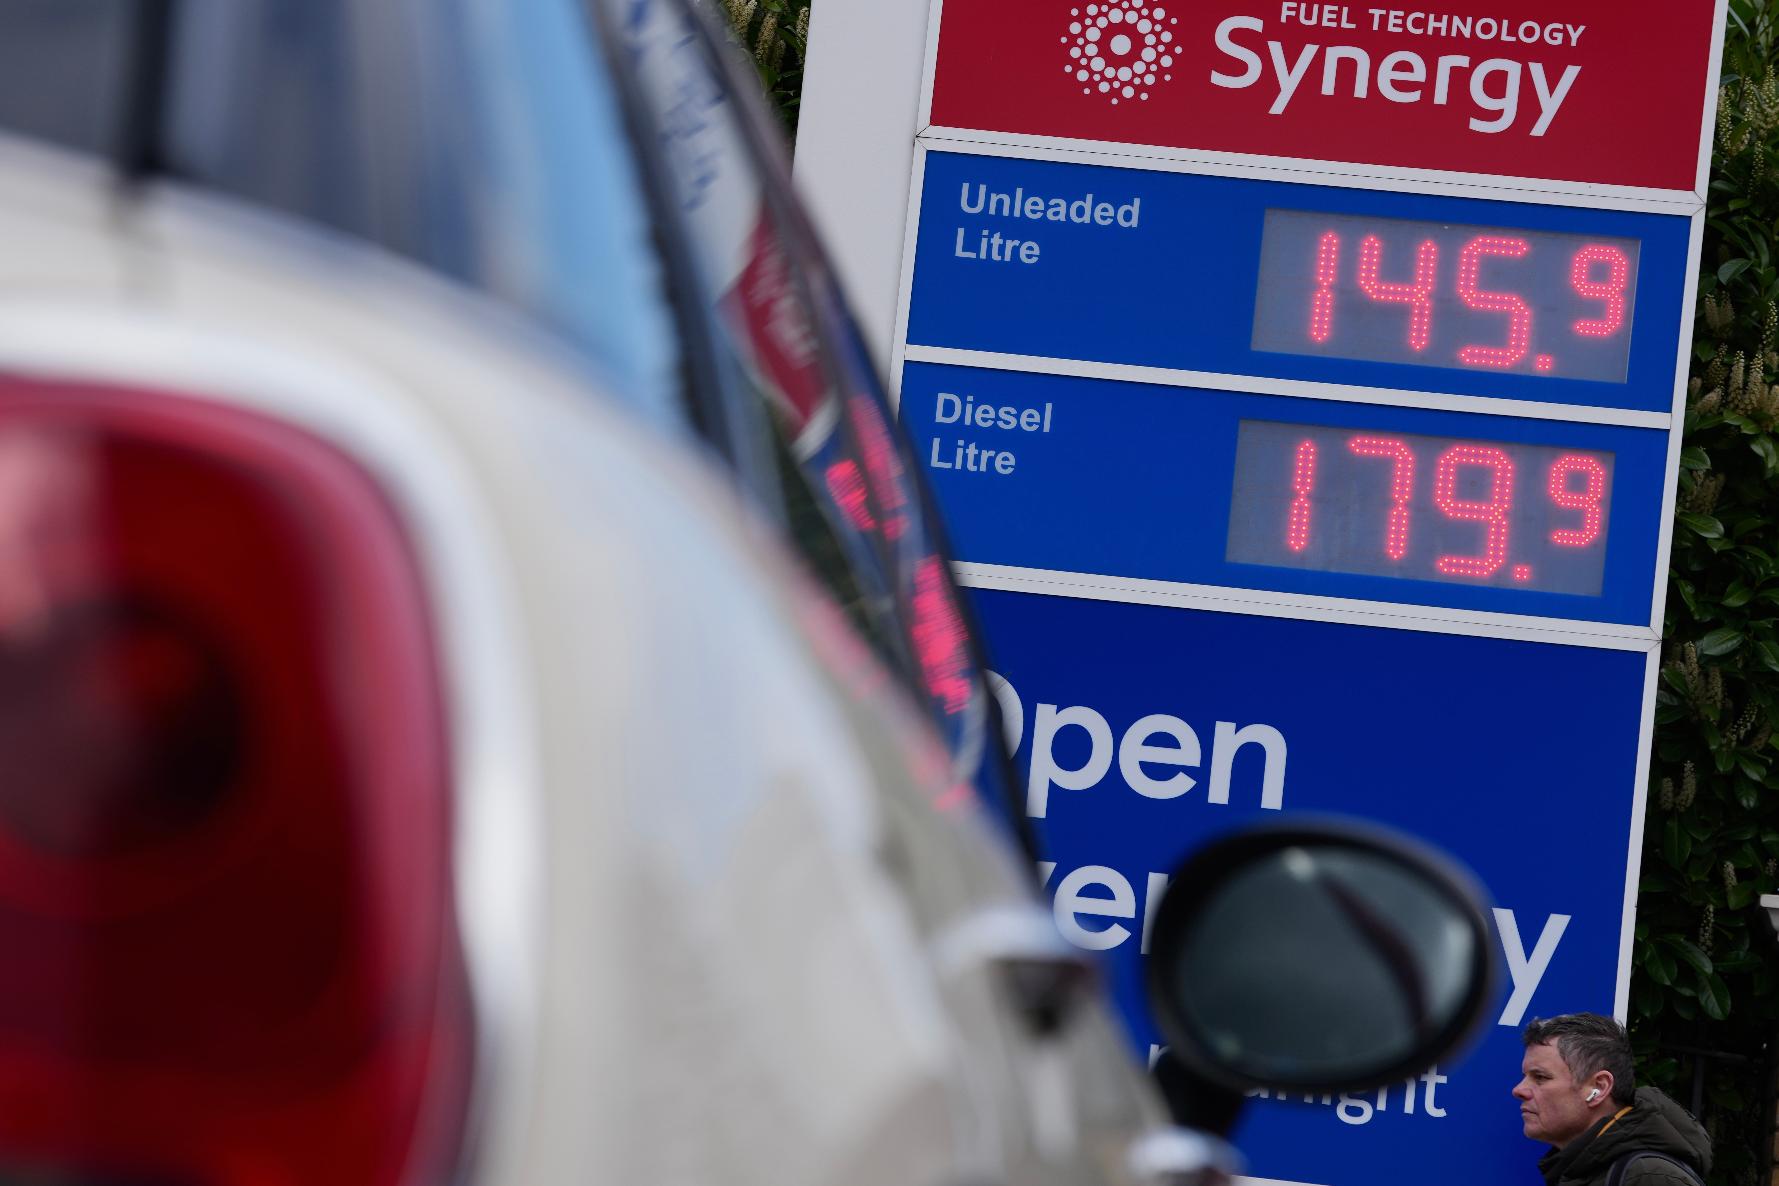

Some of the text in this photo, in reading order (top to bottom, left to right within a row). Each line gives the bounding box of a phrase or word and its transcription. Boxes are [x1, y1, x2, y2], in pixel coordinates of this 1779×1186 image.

[1280, 1, 1586, 47] FUEL TECHNOLOGY
[1210, 15, 1582, 137] Synergy
[958, 180, 1141, 230] Unleaded
[953, 227, 1040, 265] Litre
[1308, 230, 1632, 373] 145.9
[934, 392, 1054, 434] Diesel
[930, 437, 1017, 475] Litre
[1286, 434, 1608, 583] 179.9
